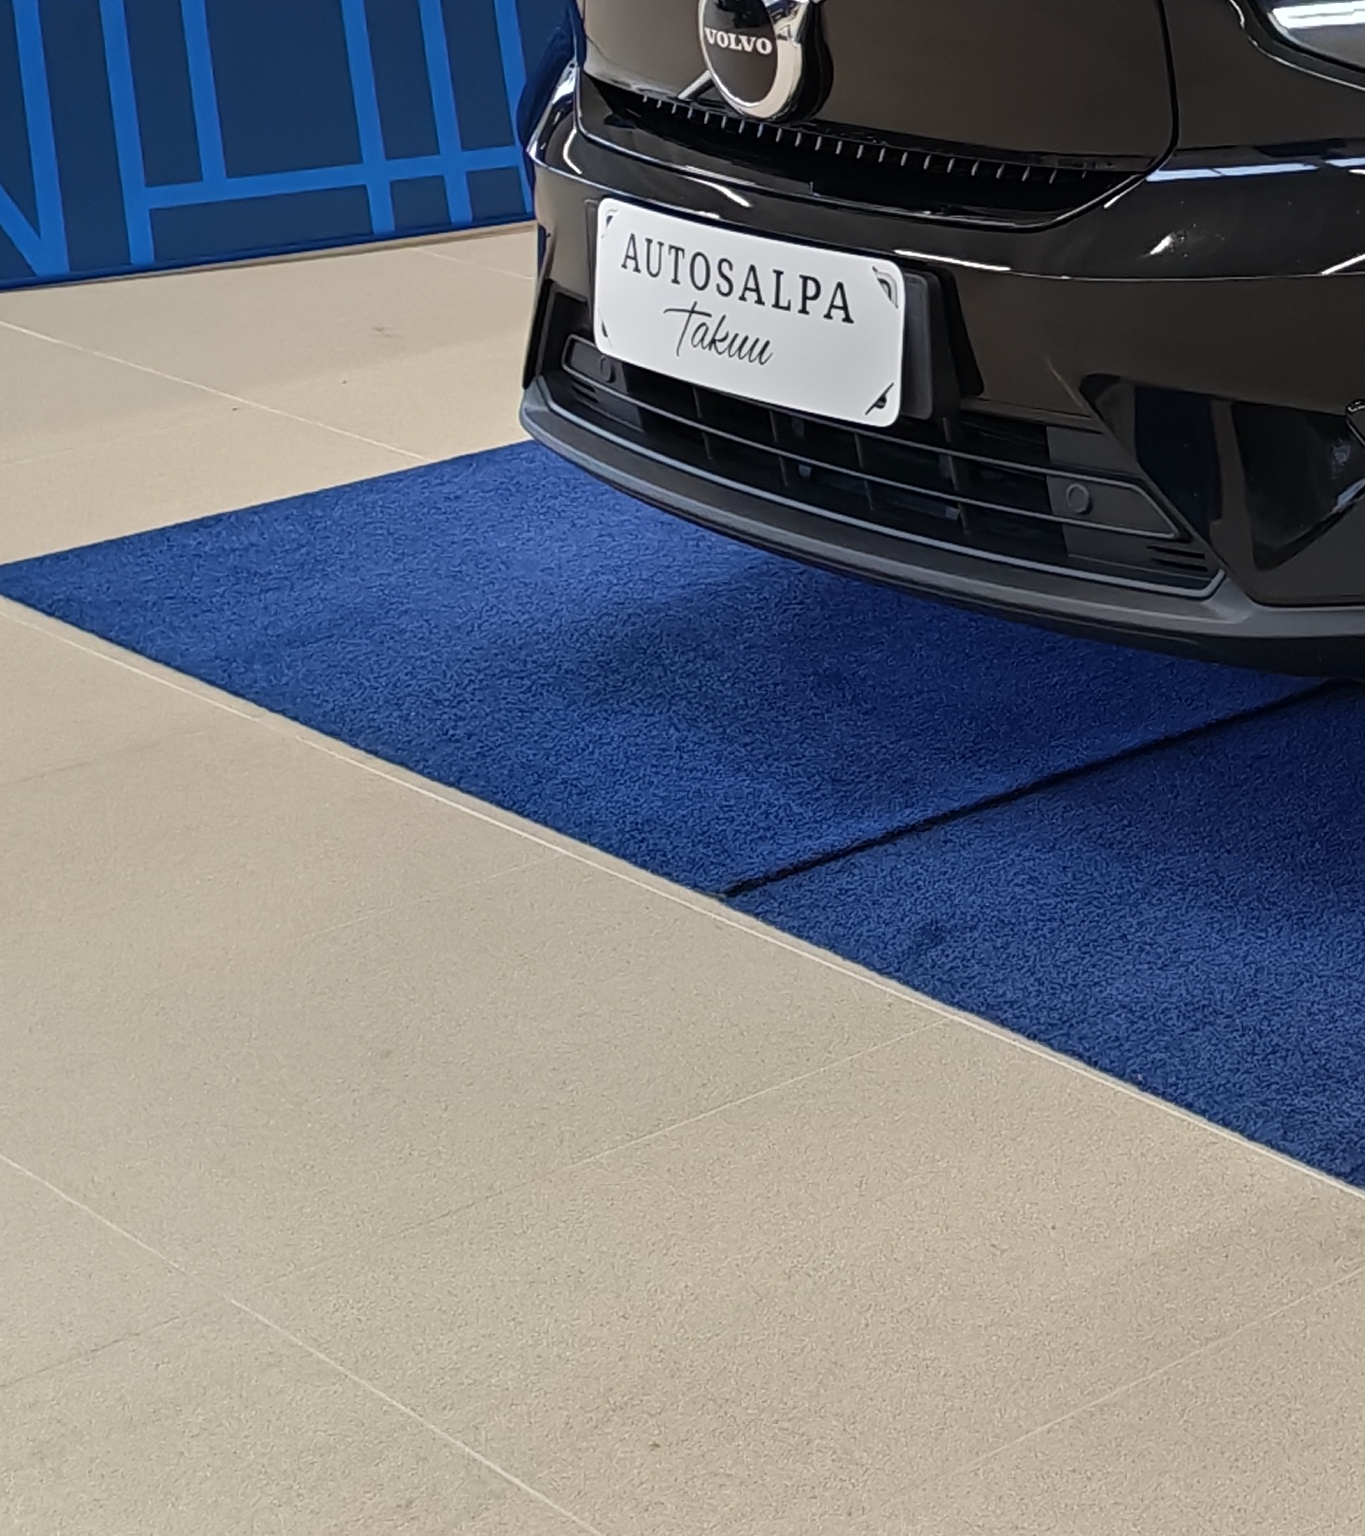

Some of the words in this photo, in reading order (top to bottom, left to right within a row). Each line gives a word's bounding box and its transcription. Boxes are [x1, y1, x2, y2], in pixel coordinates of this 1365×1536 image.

[704, 26, 773, 55] VOLVO
[620, 232, 855, 324] AUTOSALPA
[663, 301, 773, 365] Takuu
